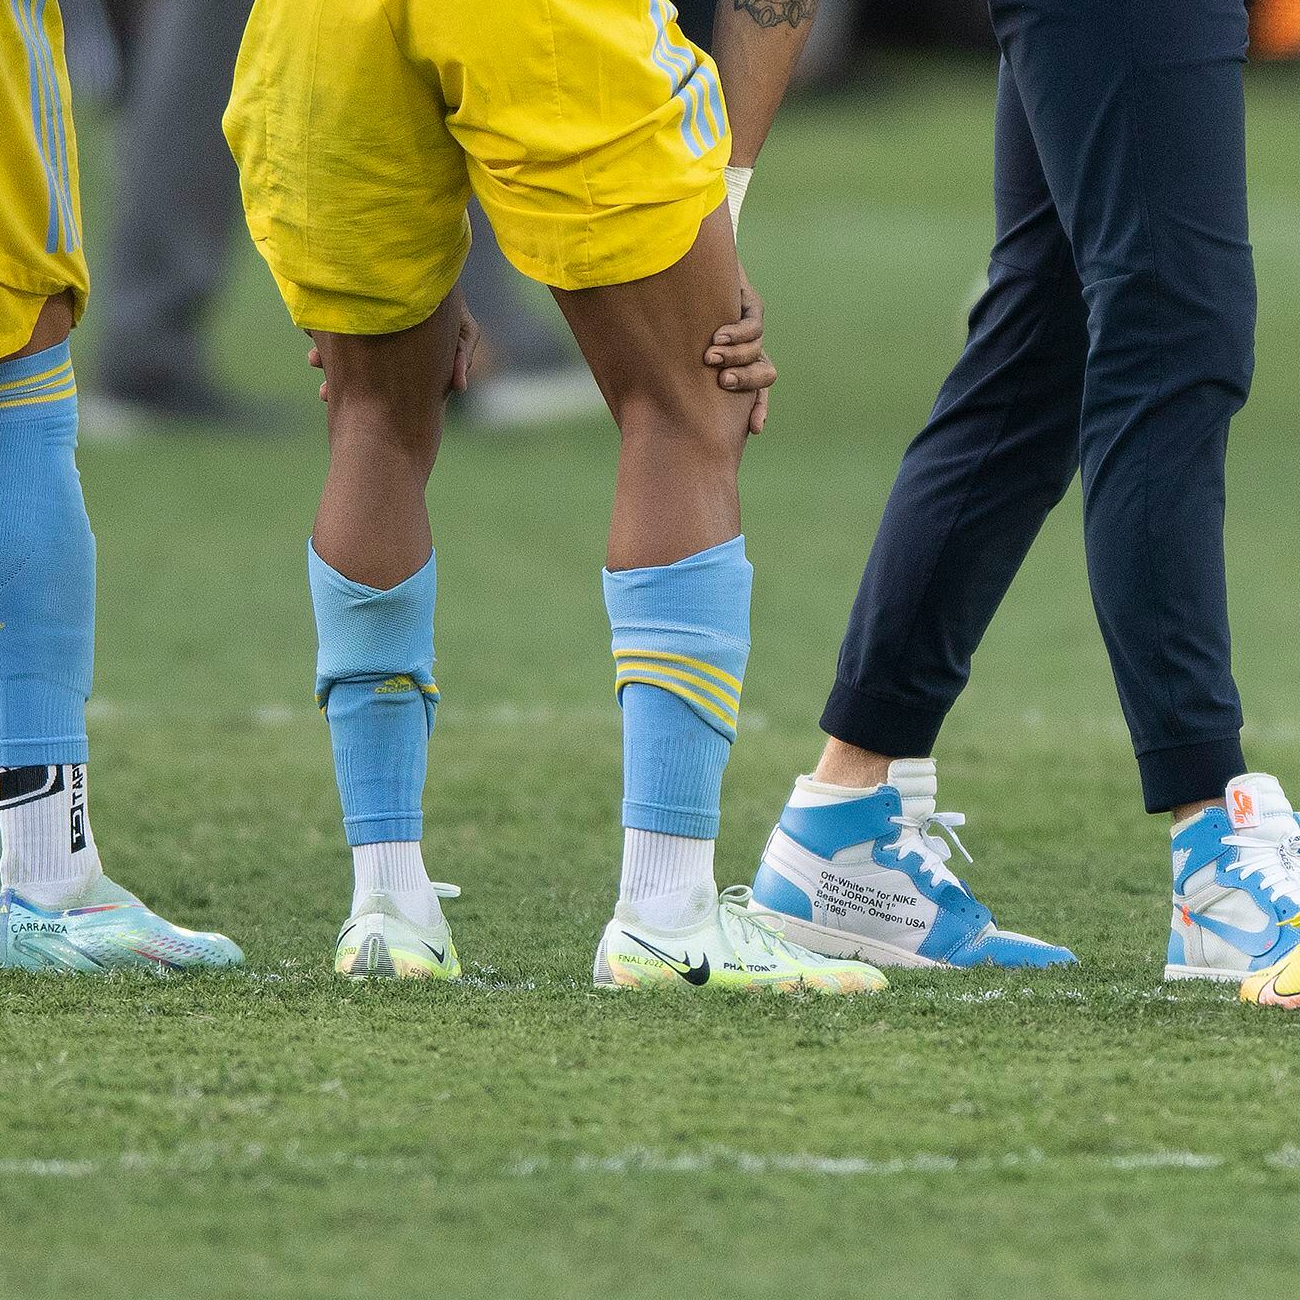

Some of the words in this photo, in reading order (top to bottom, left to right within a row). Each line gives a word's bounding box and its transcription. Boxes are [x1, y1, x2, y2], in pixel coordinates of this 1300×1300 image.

[814, 900, 822, 908] c.
[841, 889, 883, 908] JORDAN
[876, 890, 890, 900] for
[893, 894, 917, 906] NIKE
[816, 890, 866, 914] Beaverton,
[868, 908, 903, 923] Oregon
[905, 916, 926, 929] USA
[11, 922, 68, 934] CARRANZA
[618, 954, 641, 964] FINAL
[644, 957, 664, 968] 2022
[723, 961, 770, 972] PHATOM
